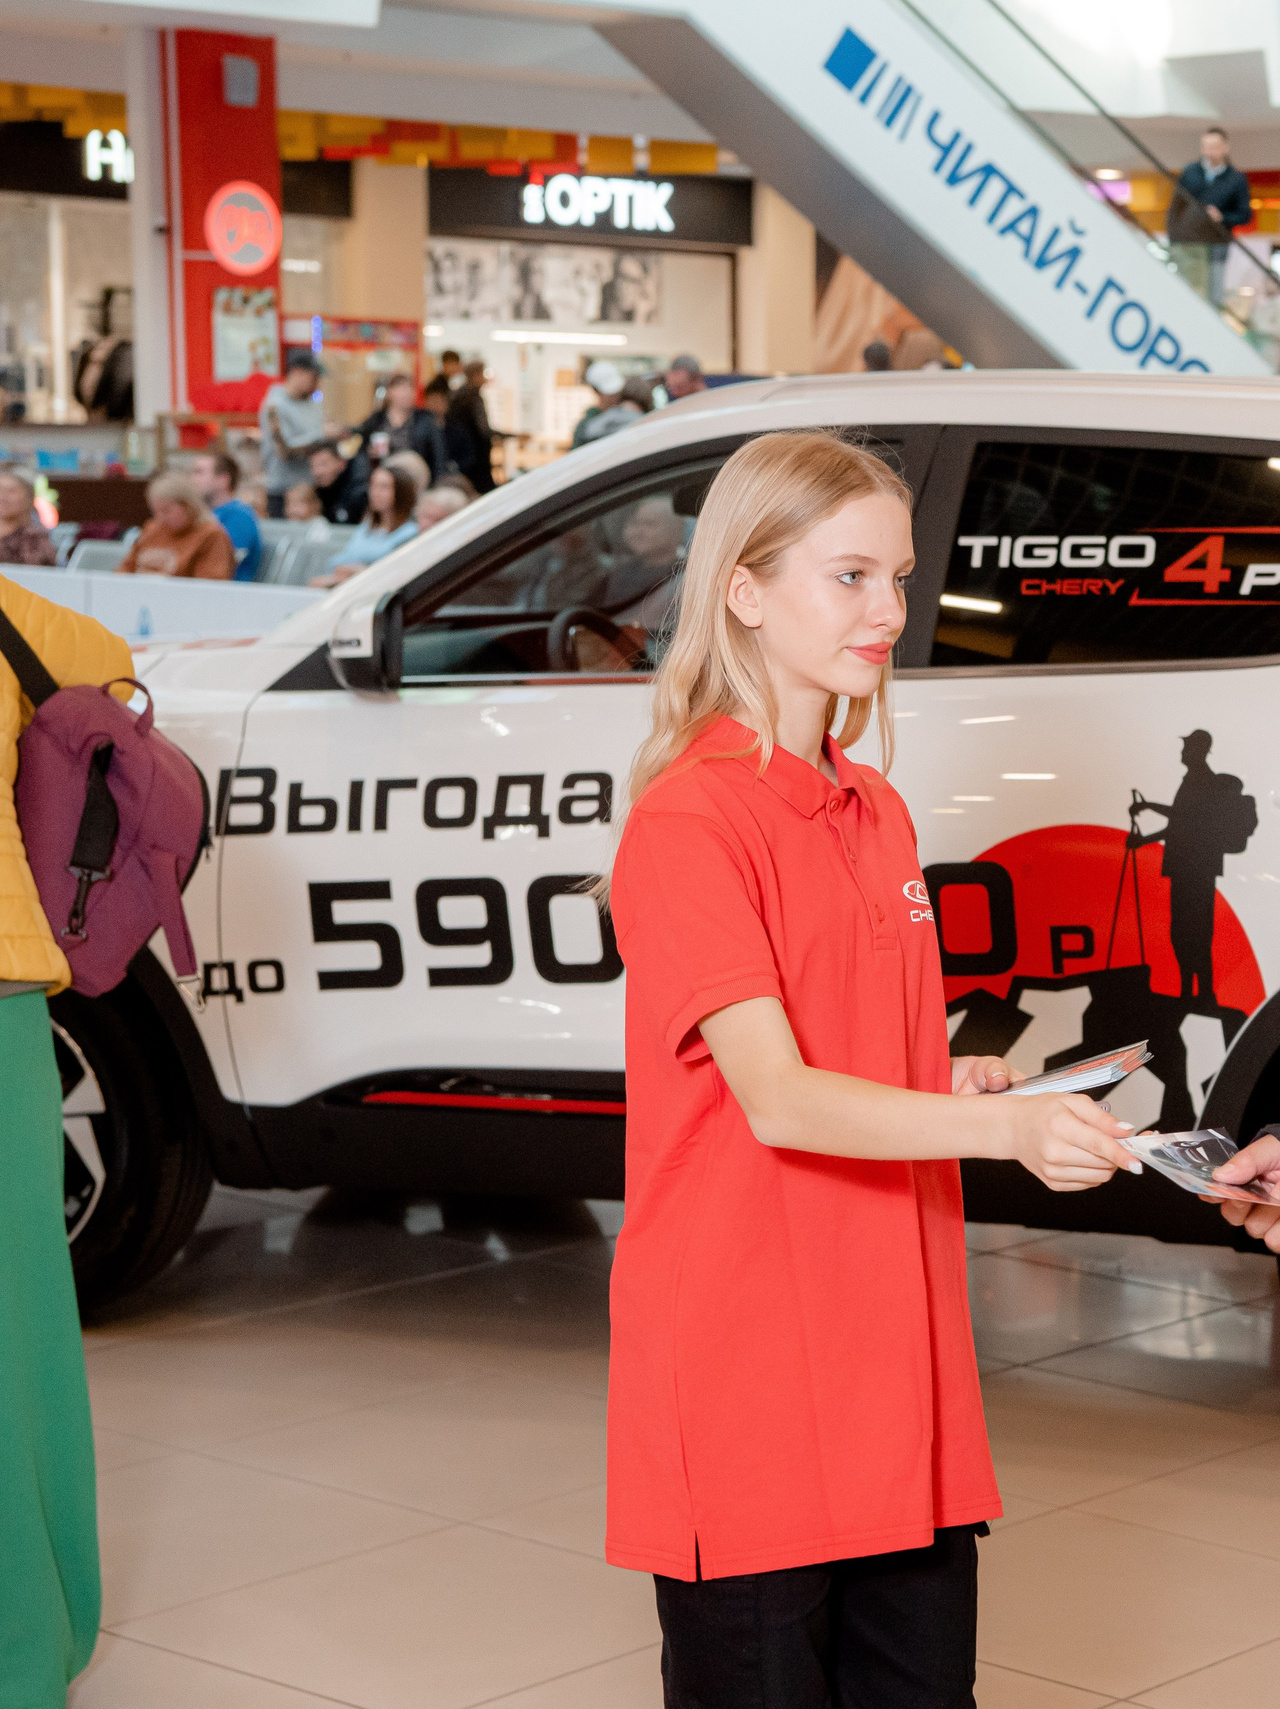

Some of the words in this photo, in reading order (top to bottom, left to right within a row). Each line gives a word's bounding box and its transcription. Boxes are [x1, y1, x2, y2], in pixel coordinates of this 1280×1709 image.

[957, 535, 1157, 569] TIGGO
[1163, 535, 1232, 594] 4
[1020, 578, 1125, 596] CHERY
[215, 767, 615, 840] Выгода
[203, 959, 285, 1003] до
